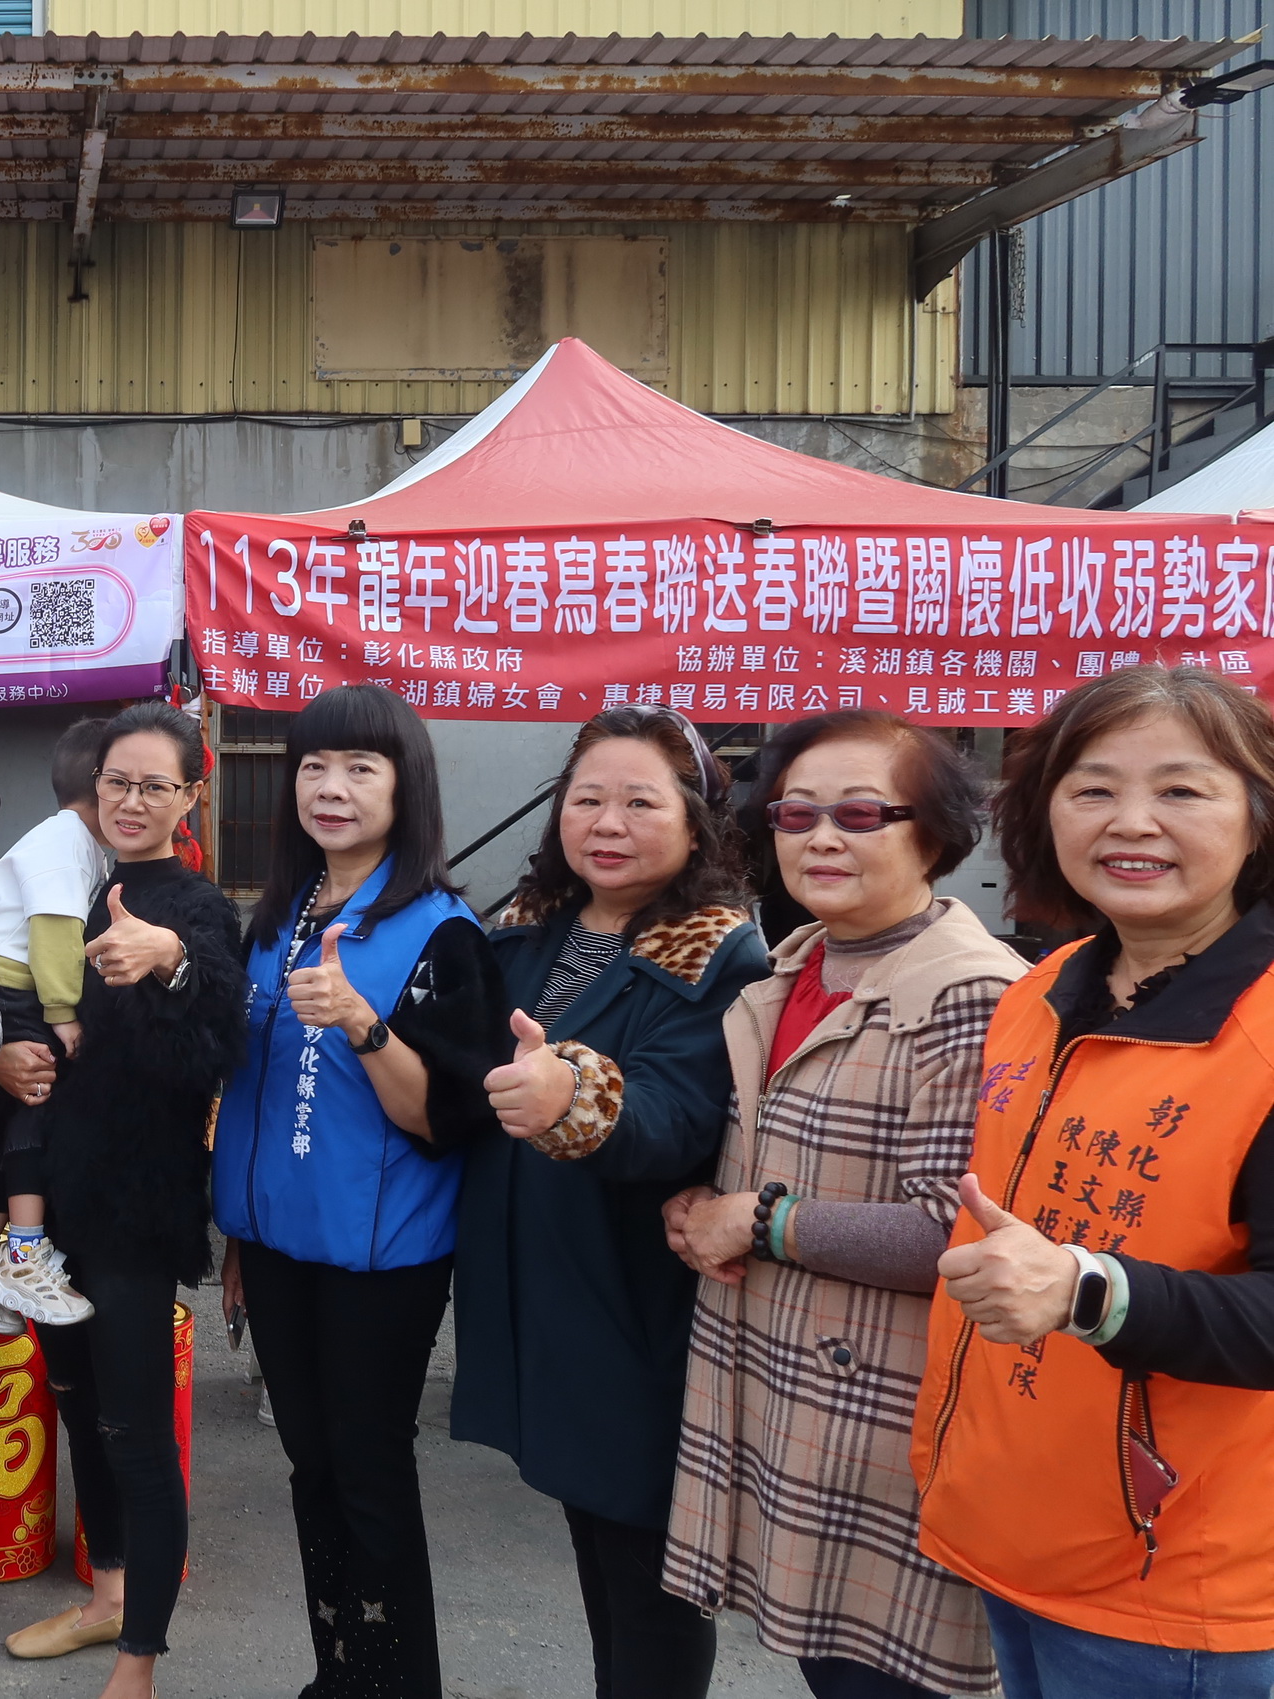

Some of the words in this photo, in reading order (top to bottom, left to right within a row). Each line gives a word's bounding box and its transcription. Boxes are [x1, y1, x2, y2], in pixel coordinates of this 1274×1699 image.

[201, 530, 1274, 639] 113年龍年迎春寫春聯送春聯暨關懷低收弱勢家
[202, 627, 524, 672] 指導單位：彰化縣政府
